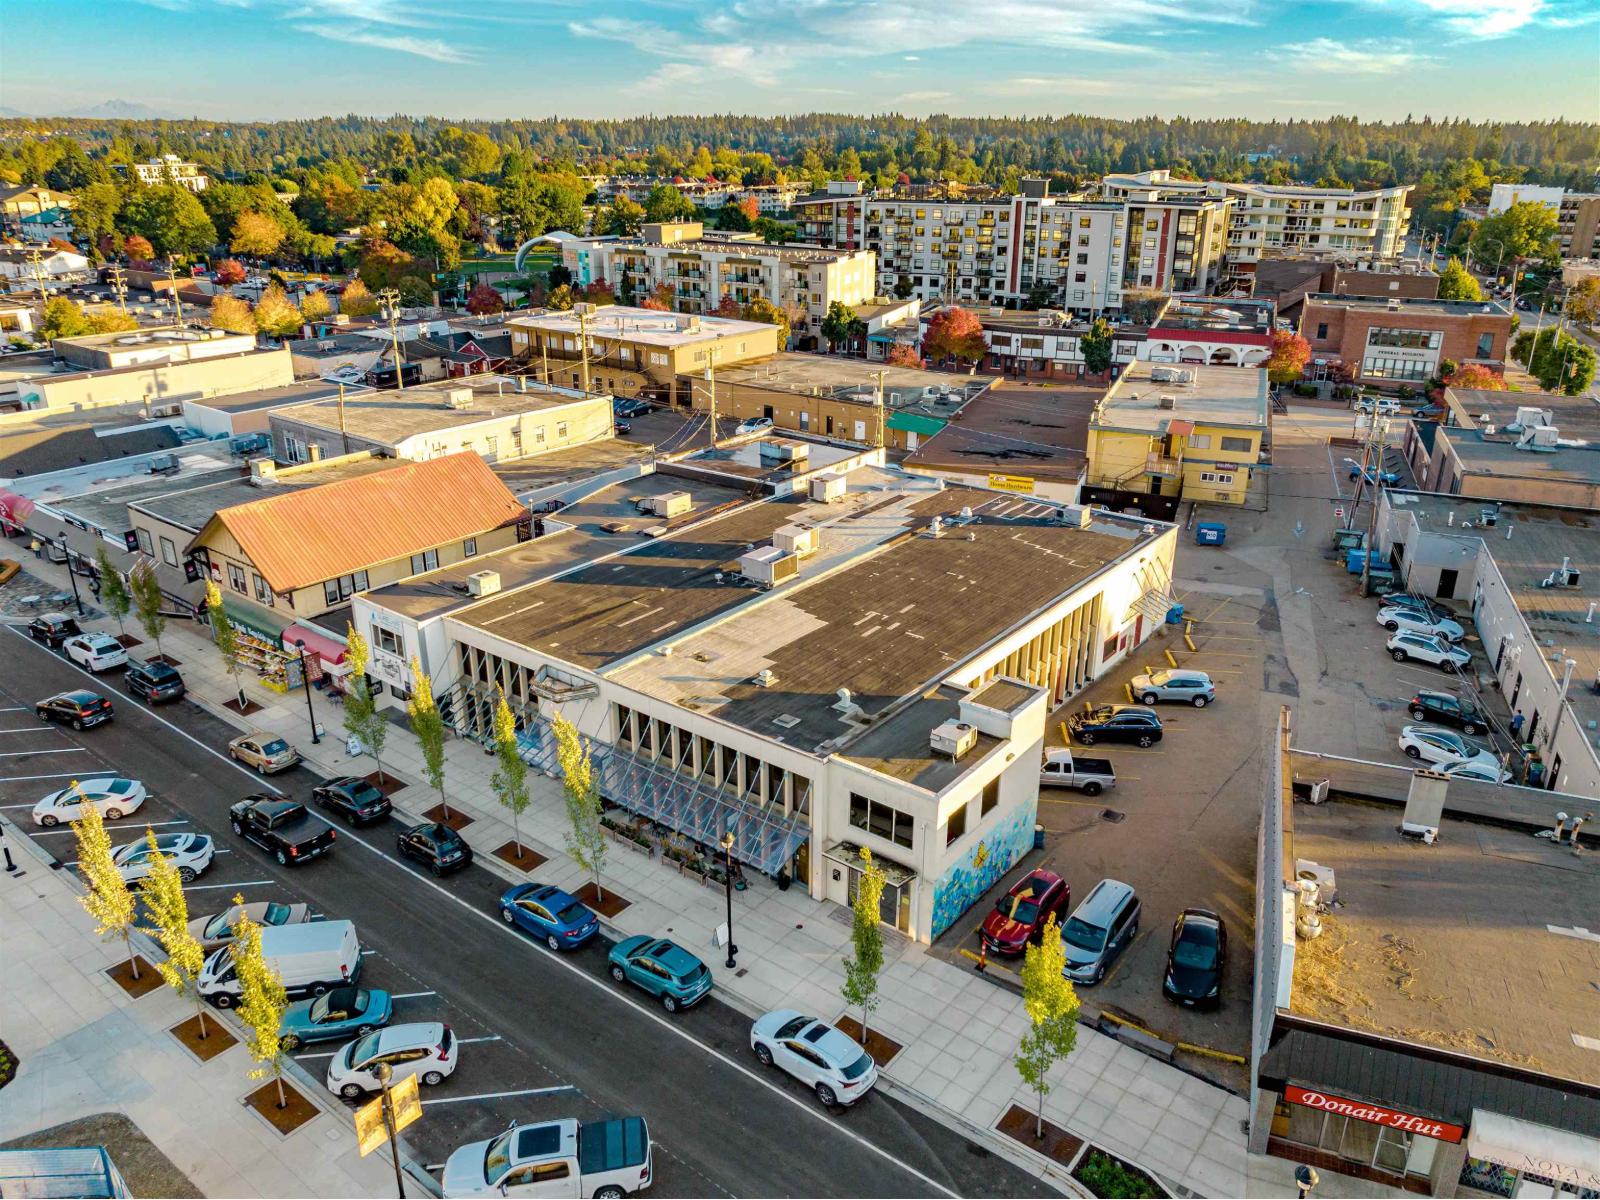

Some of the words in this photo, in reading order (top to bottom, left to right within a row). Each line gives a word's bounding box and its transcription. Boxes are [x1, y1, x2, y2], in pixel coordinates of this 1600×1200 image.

[1302, 1092, 1389, 1121] Donair
[1389, 1113, 1443, 1136] Hut
[1524, 1154, 1580, 1180] NOVA
